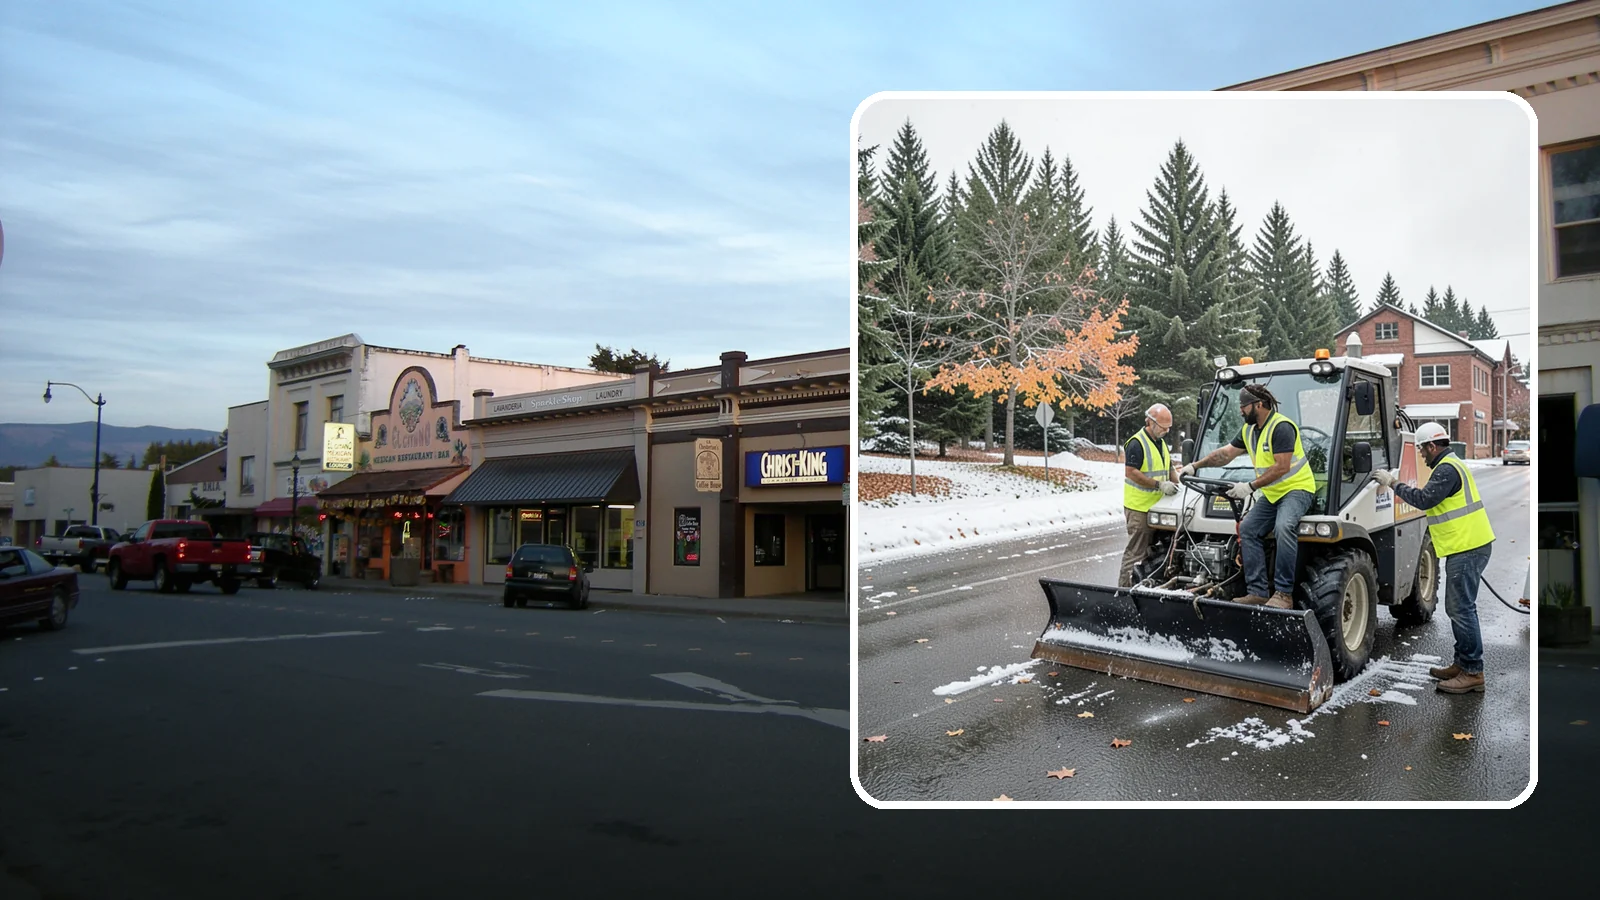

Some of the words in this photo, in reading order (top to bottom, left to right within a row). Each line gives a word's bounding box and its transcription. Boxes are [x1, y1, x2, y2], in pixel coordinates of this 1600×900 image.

[595, 389, 624, 400] LAUNDRY
[562, 395, 582, 407] Shop
[494, 402, 522, 412] LAVANDERIA
[397, 451, 433, 462] RESTAURANT
[437, 450, 450, 459] BAR
[761, 452, 797, 478] CHRIST
[799, 450, 827, 476] KING
[696, 481, 709, 489] Coffee
